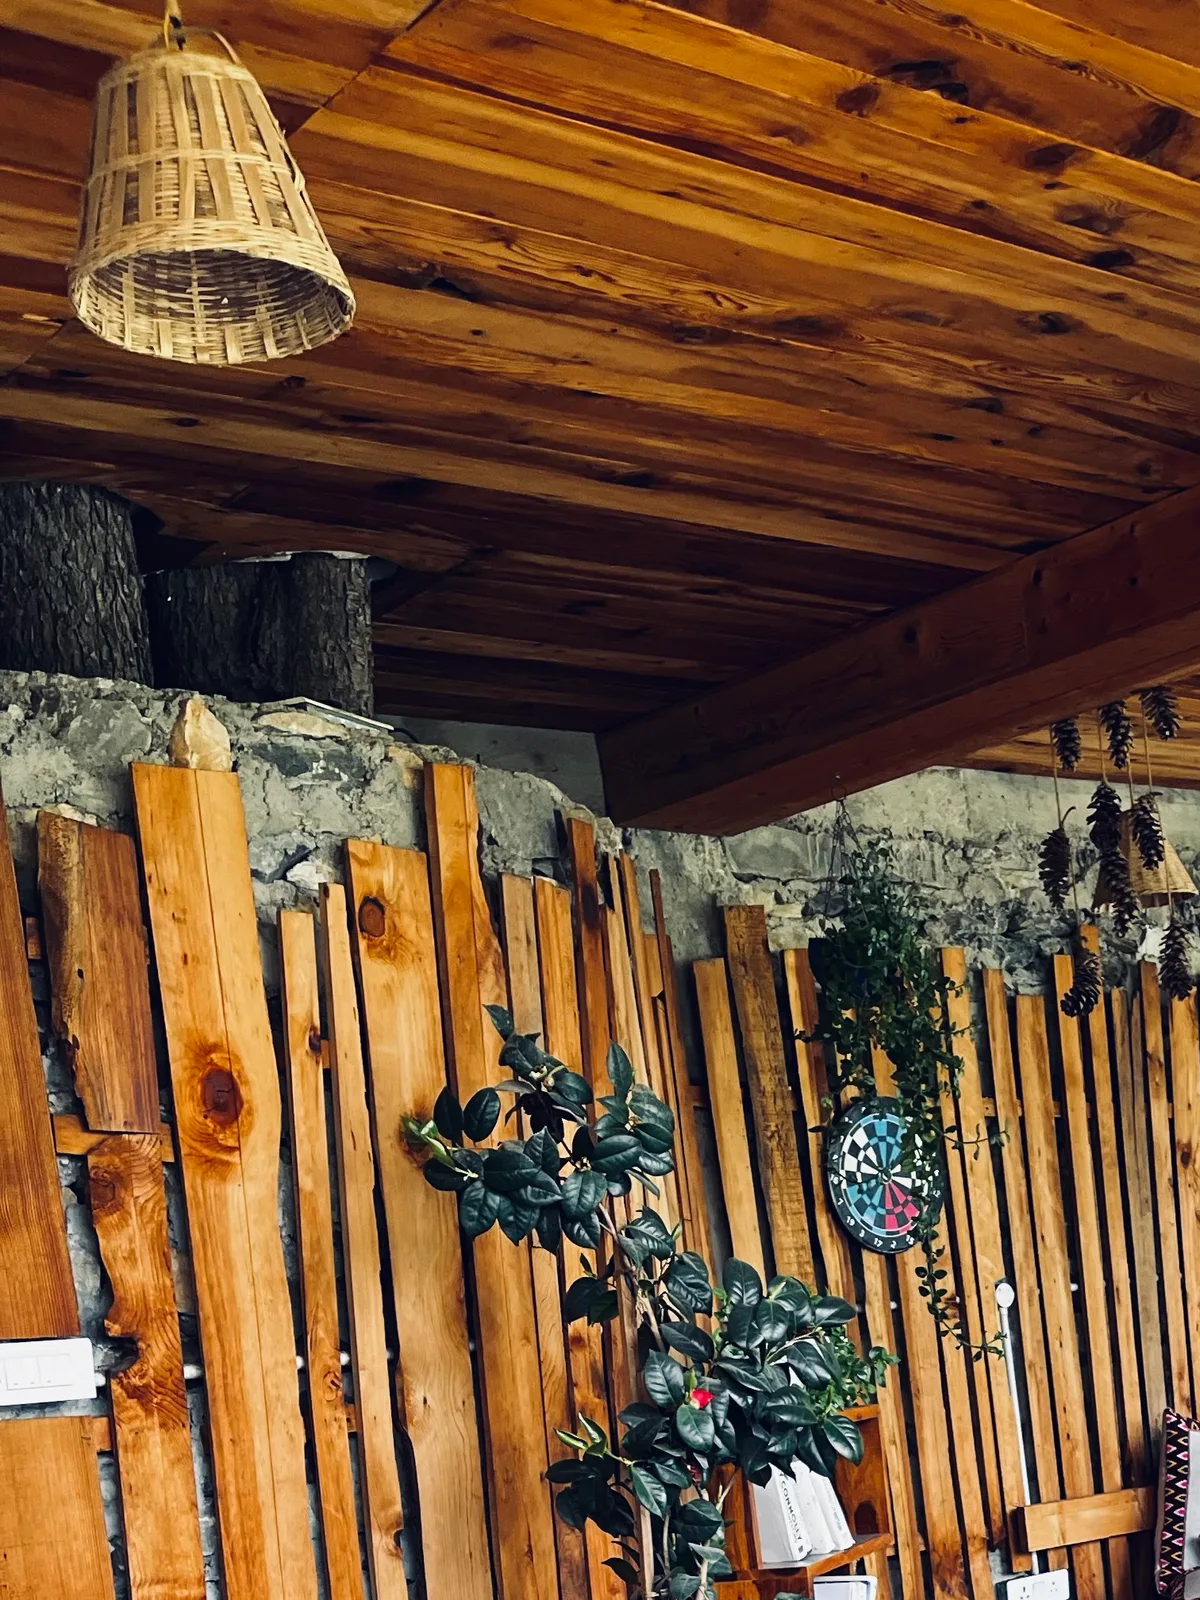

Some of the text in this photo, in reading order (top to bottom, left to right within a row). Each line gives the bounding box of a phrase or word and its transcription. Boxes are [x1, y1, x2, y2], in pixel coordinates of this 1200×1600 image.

[846, 1216, 856, 1226] 19
[859, 1230, 865, 1238] 3
[874, 1238, 883, 1247] 17
[890, 1241, 897, 1249] 2
